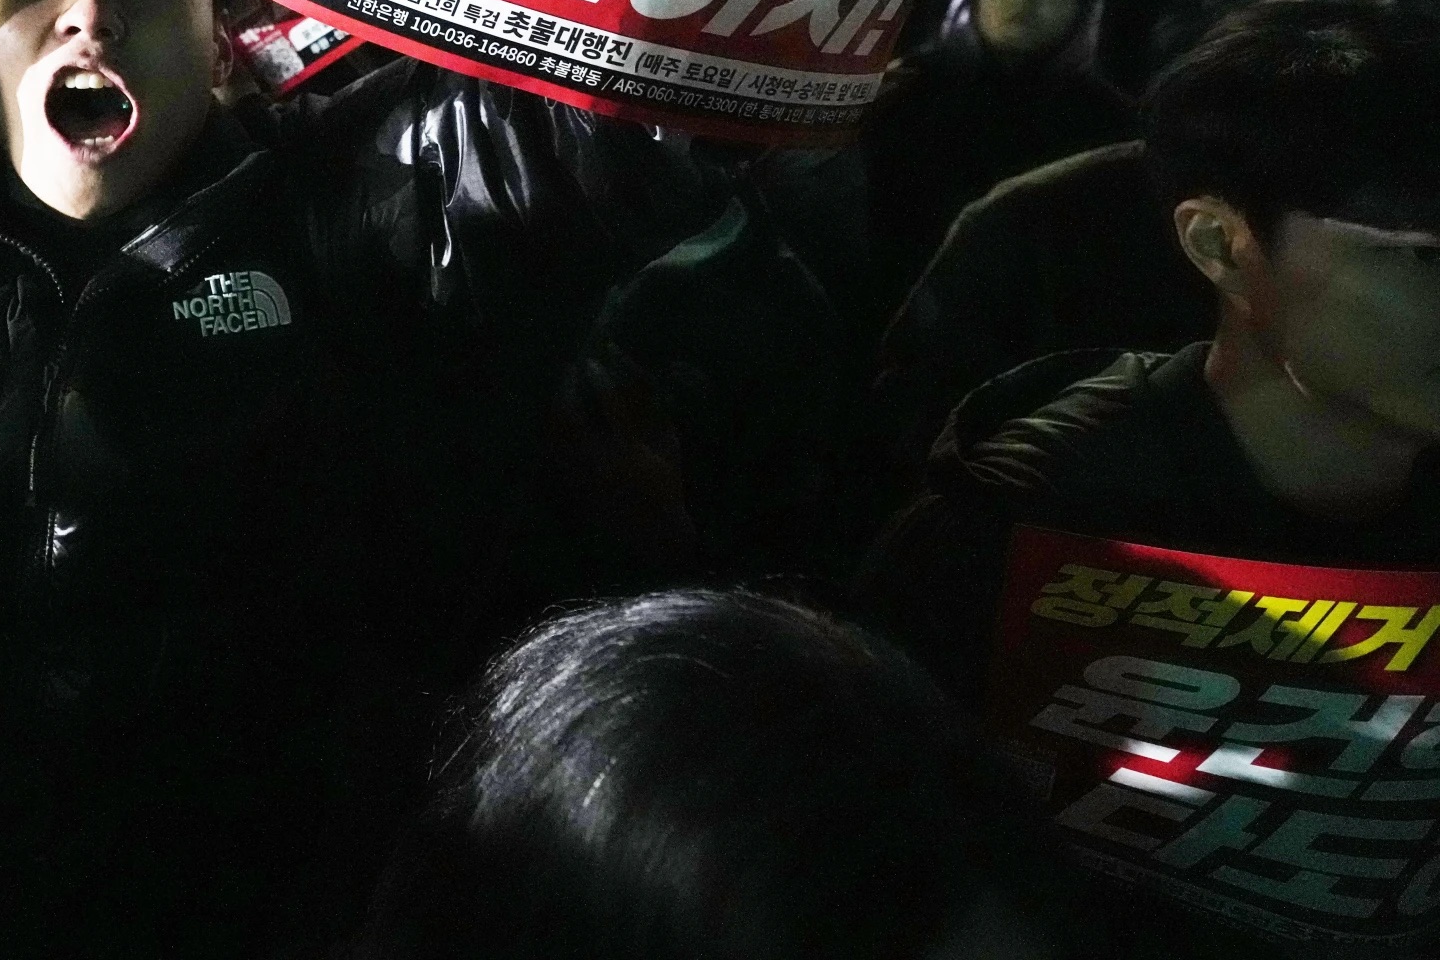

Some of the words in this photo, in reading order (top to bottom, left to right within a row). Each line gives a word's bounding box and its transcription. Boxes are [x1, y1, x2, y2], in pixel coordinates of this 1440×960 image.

[410, 16, 537, 67] 100-036-164860
[538, 56, 603, 87] 촛불행동
[613, 78, 646, 97] ARS
[647, 86, 737, 113] 060-707-3300
[463, 3, 501, 29] 특검
[503, 10, 634, 68] 촛불대행진
[634, 52, 682, 78] (매주
[681, 62, 736, 89] 토요일
[172, 290, 255, 320] NORTH
[199, 310, 258, 337] FACE
[205, 271, 251, 294] THE
[1031, 563, 1440, 671] 정적제거
[1028, 655, 1440, 801] 윤건
[1059, 767, 1440, 918] 타도
